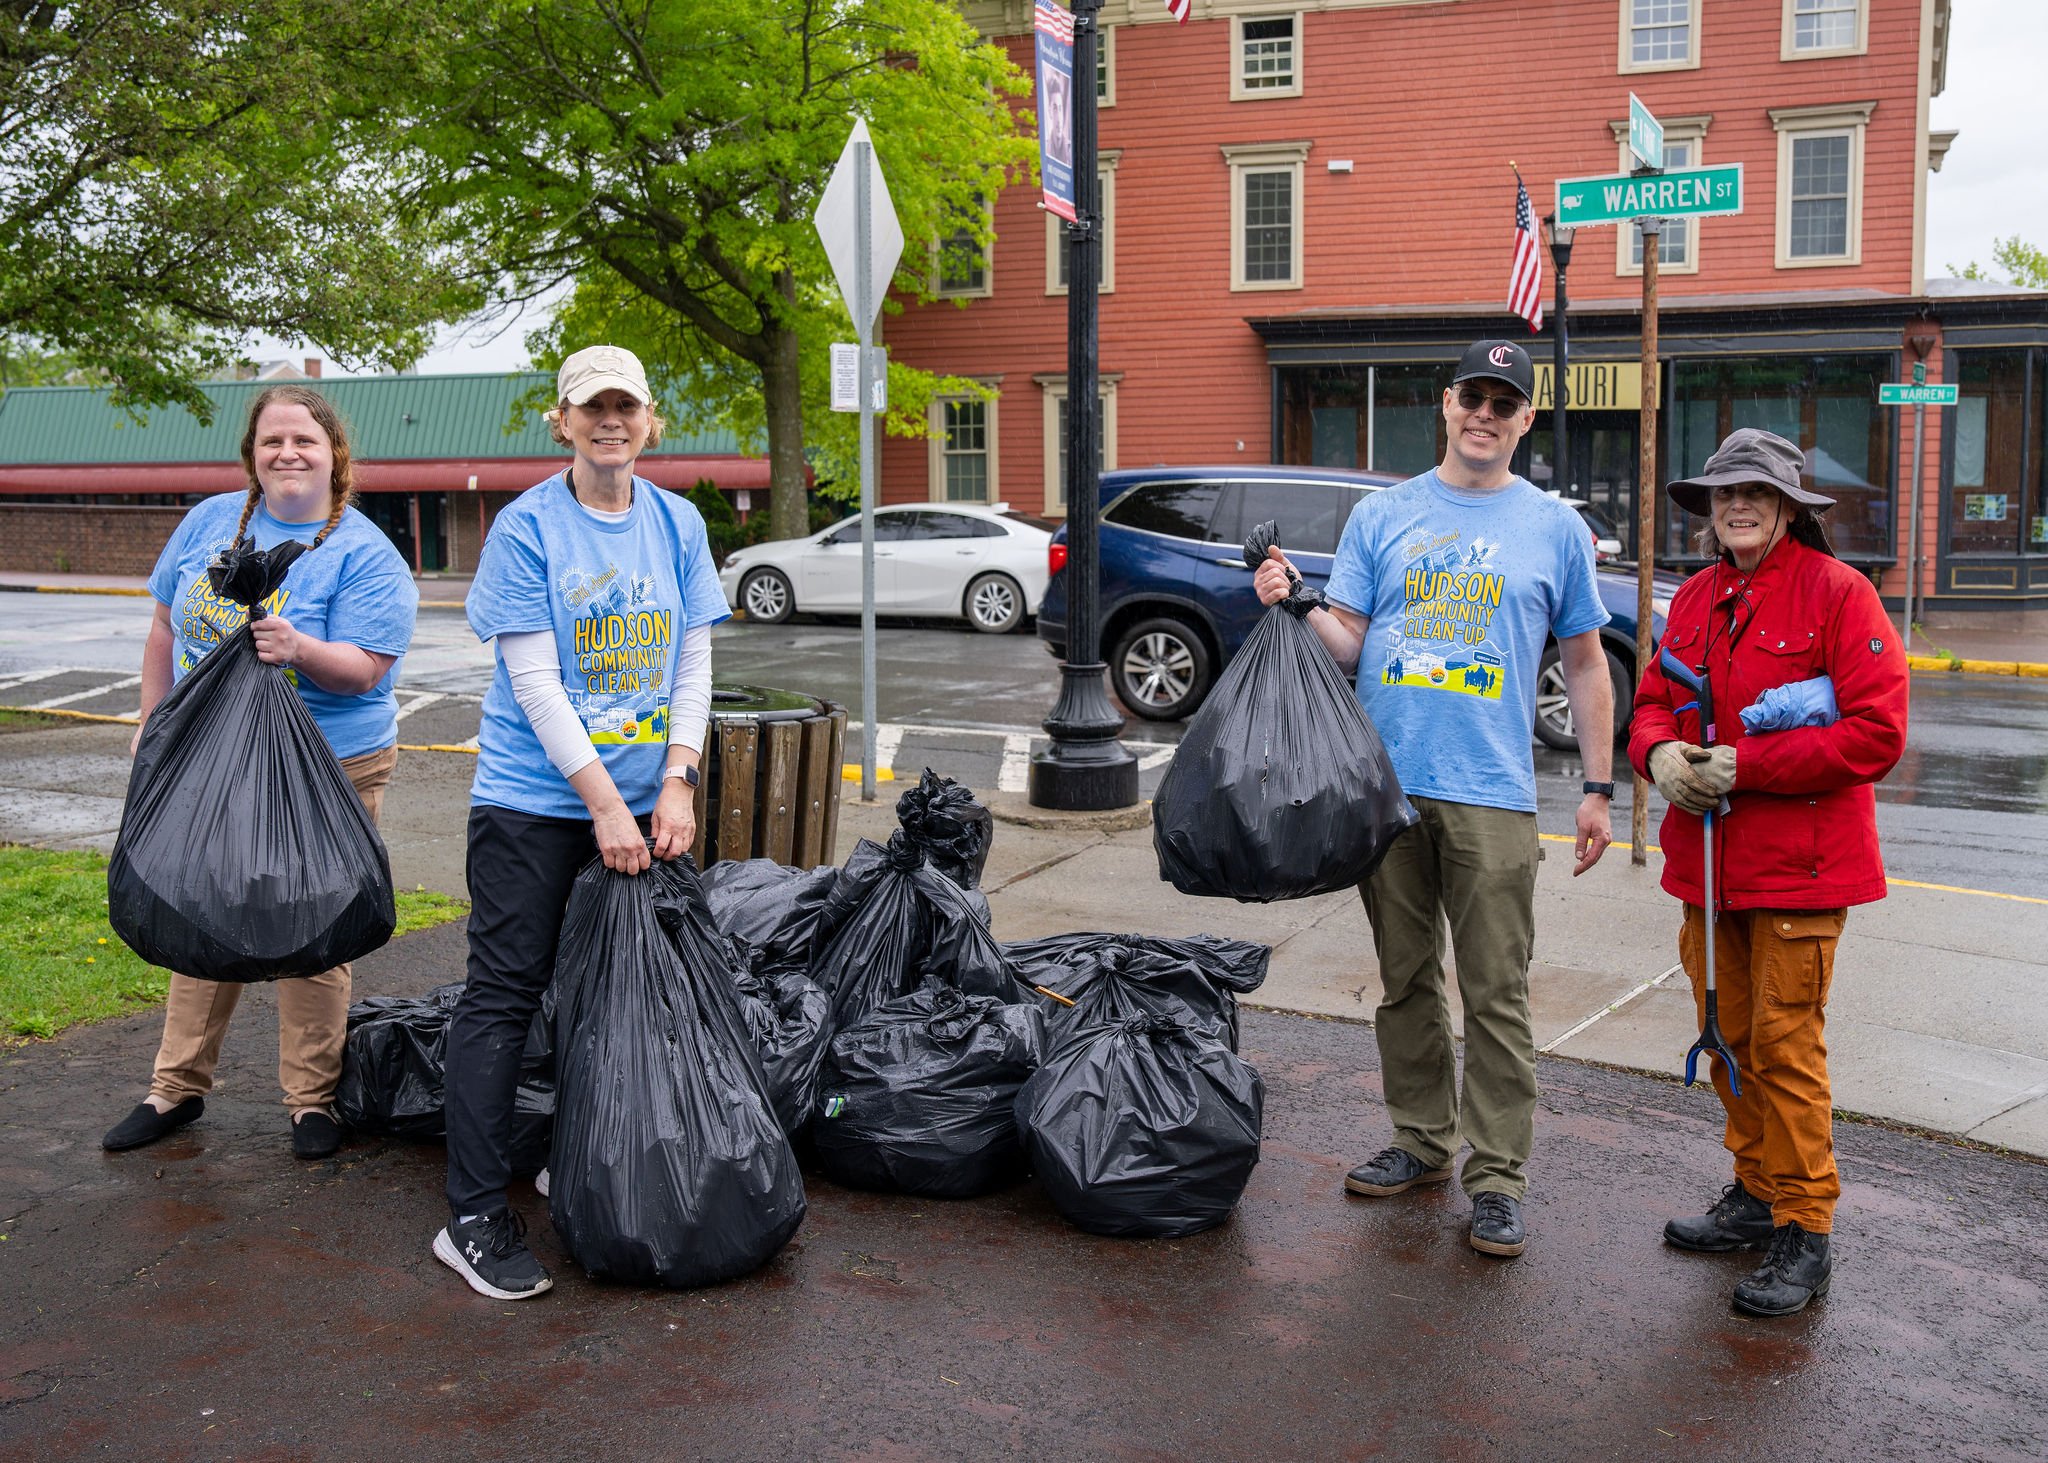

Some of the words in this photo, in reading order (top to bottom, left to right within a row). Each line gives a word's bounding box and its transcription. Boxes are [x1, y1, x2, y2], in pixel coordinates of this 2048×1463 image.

[1603, 177, 1711, 213] WARREN
[1716, 182, 1733, 198] ST
[1488, 345, 1514, 368] C
[1899, 388, 1945, 401] WARREN
[1404, 567, 1506, 608] HUDSON
[1405, 600, 1496, 627] COMMUNITY
[575, 608, 672, 655] HUDSON
[1404, 618, 1487, 647] CLEAN-UP
[579, 647, 669, 674] COMMUNITY
[587, 670, 664, 695] CLEAN-UP
